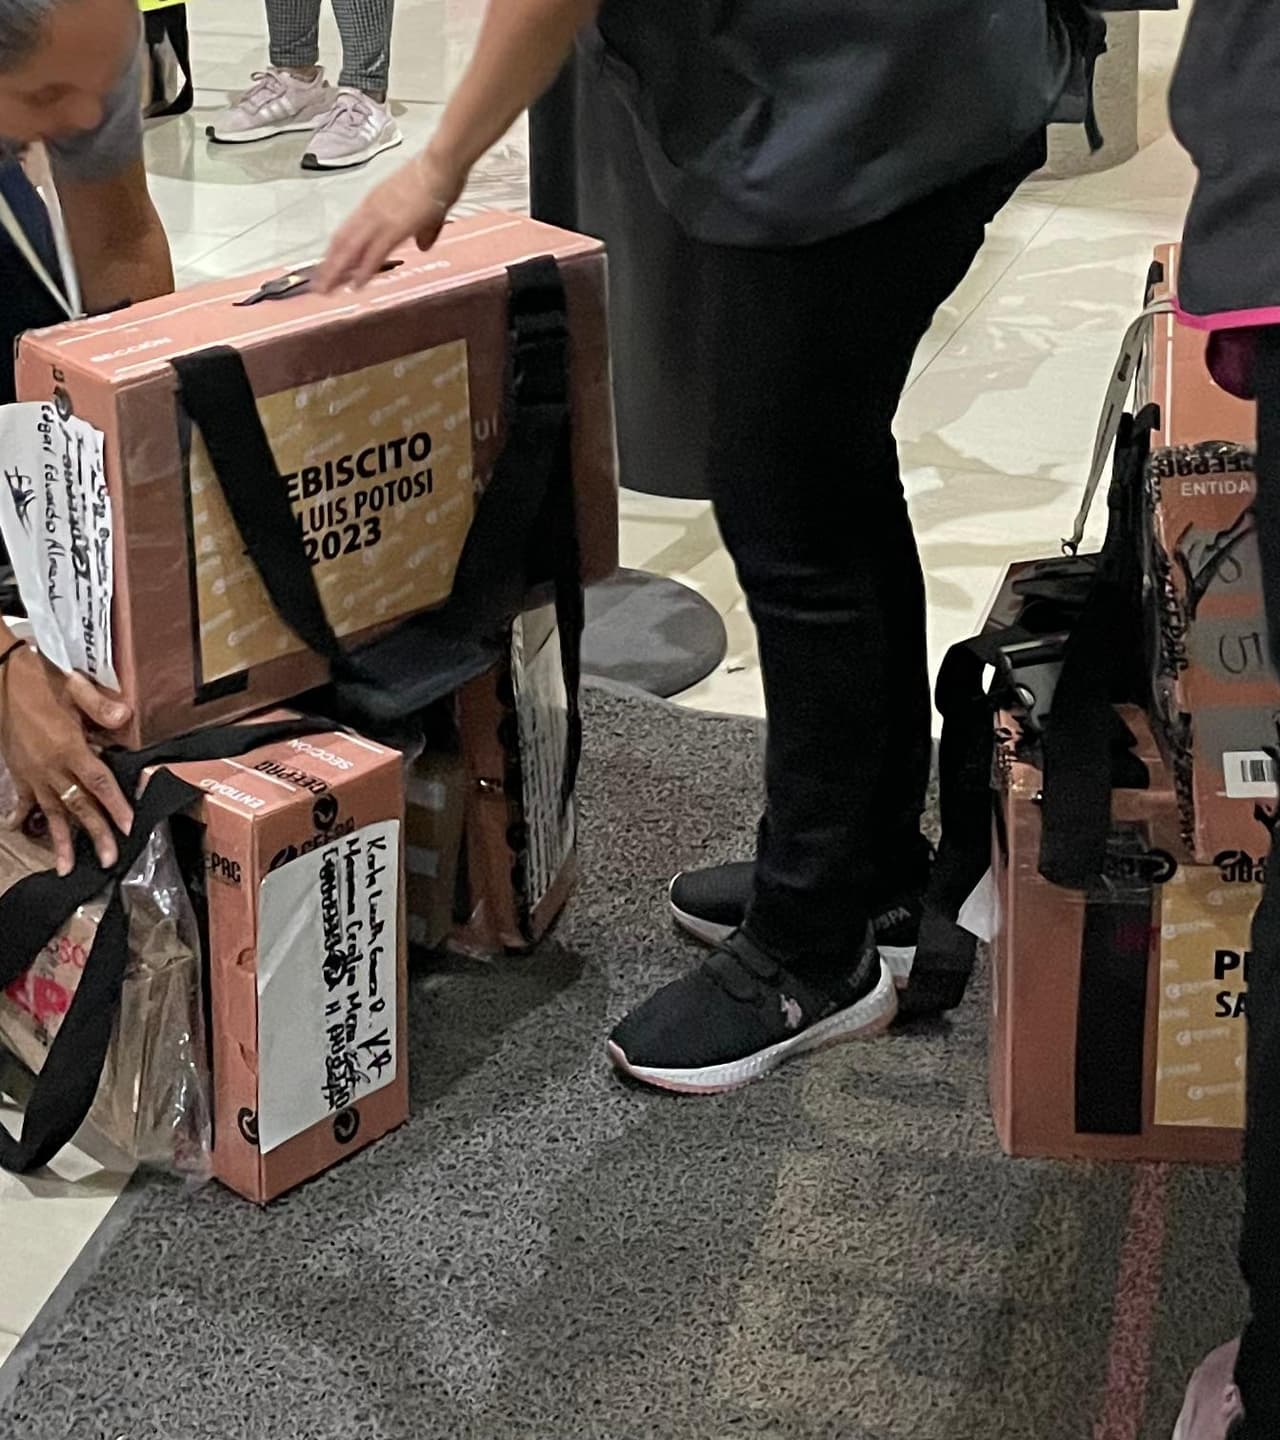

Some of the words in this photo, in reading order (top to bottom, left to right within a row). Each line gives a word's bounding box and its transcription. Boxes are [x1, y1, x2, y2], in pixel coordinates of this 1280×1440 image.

[286, 432, 432, 502] EBISCITO
[1181, 479, 1252, 496] ENTIDA
[303, 517, 381, 566] 2023
[199, 778, 266, 809] ENTIDAD
[207, 851, 242, 883] PAC
[1215, 991, 1247, 1018] SA
